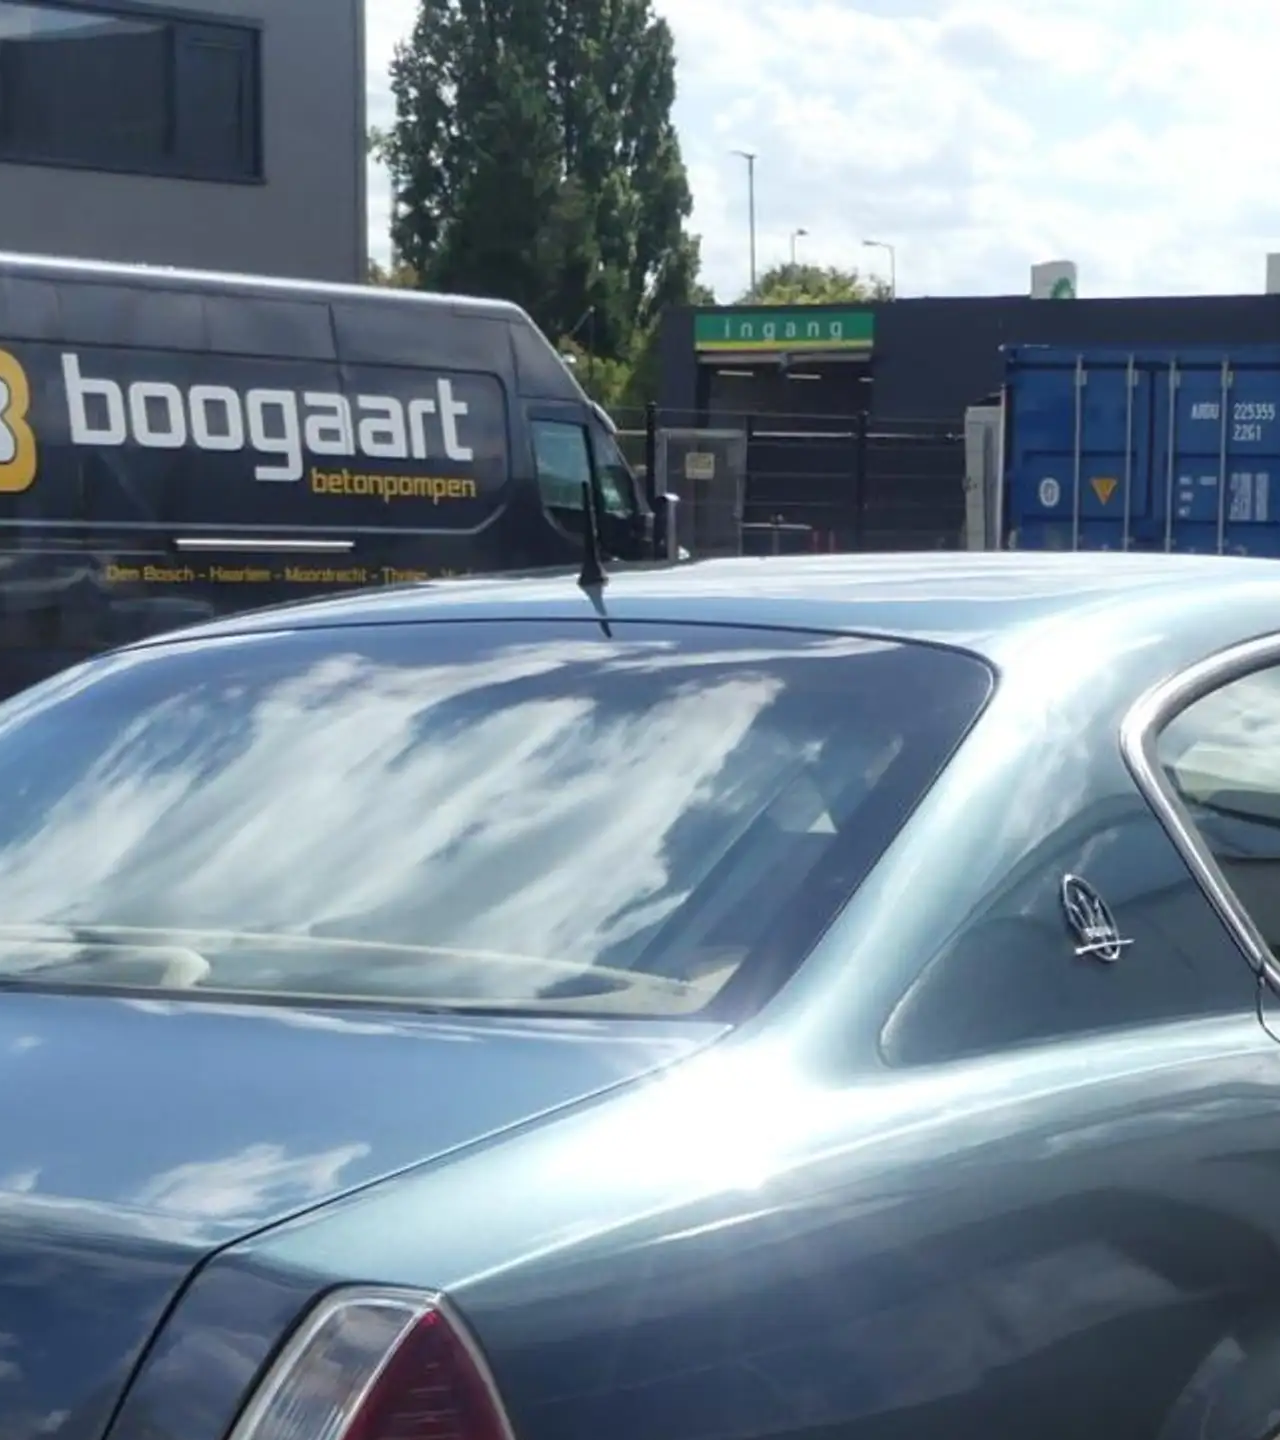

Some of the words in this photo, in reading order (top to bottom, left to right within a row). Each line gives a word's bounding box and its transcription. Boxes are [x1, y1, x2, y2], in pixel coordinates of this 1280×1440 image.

[724, 318, 843, 343] ingang
[61, 352, 474, 481] boogaart
[311, 467, 477, 505] betonpompen
